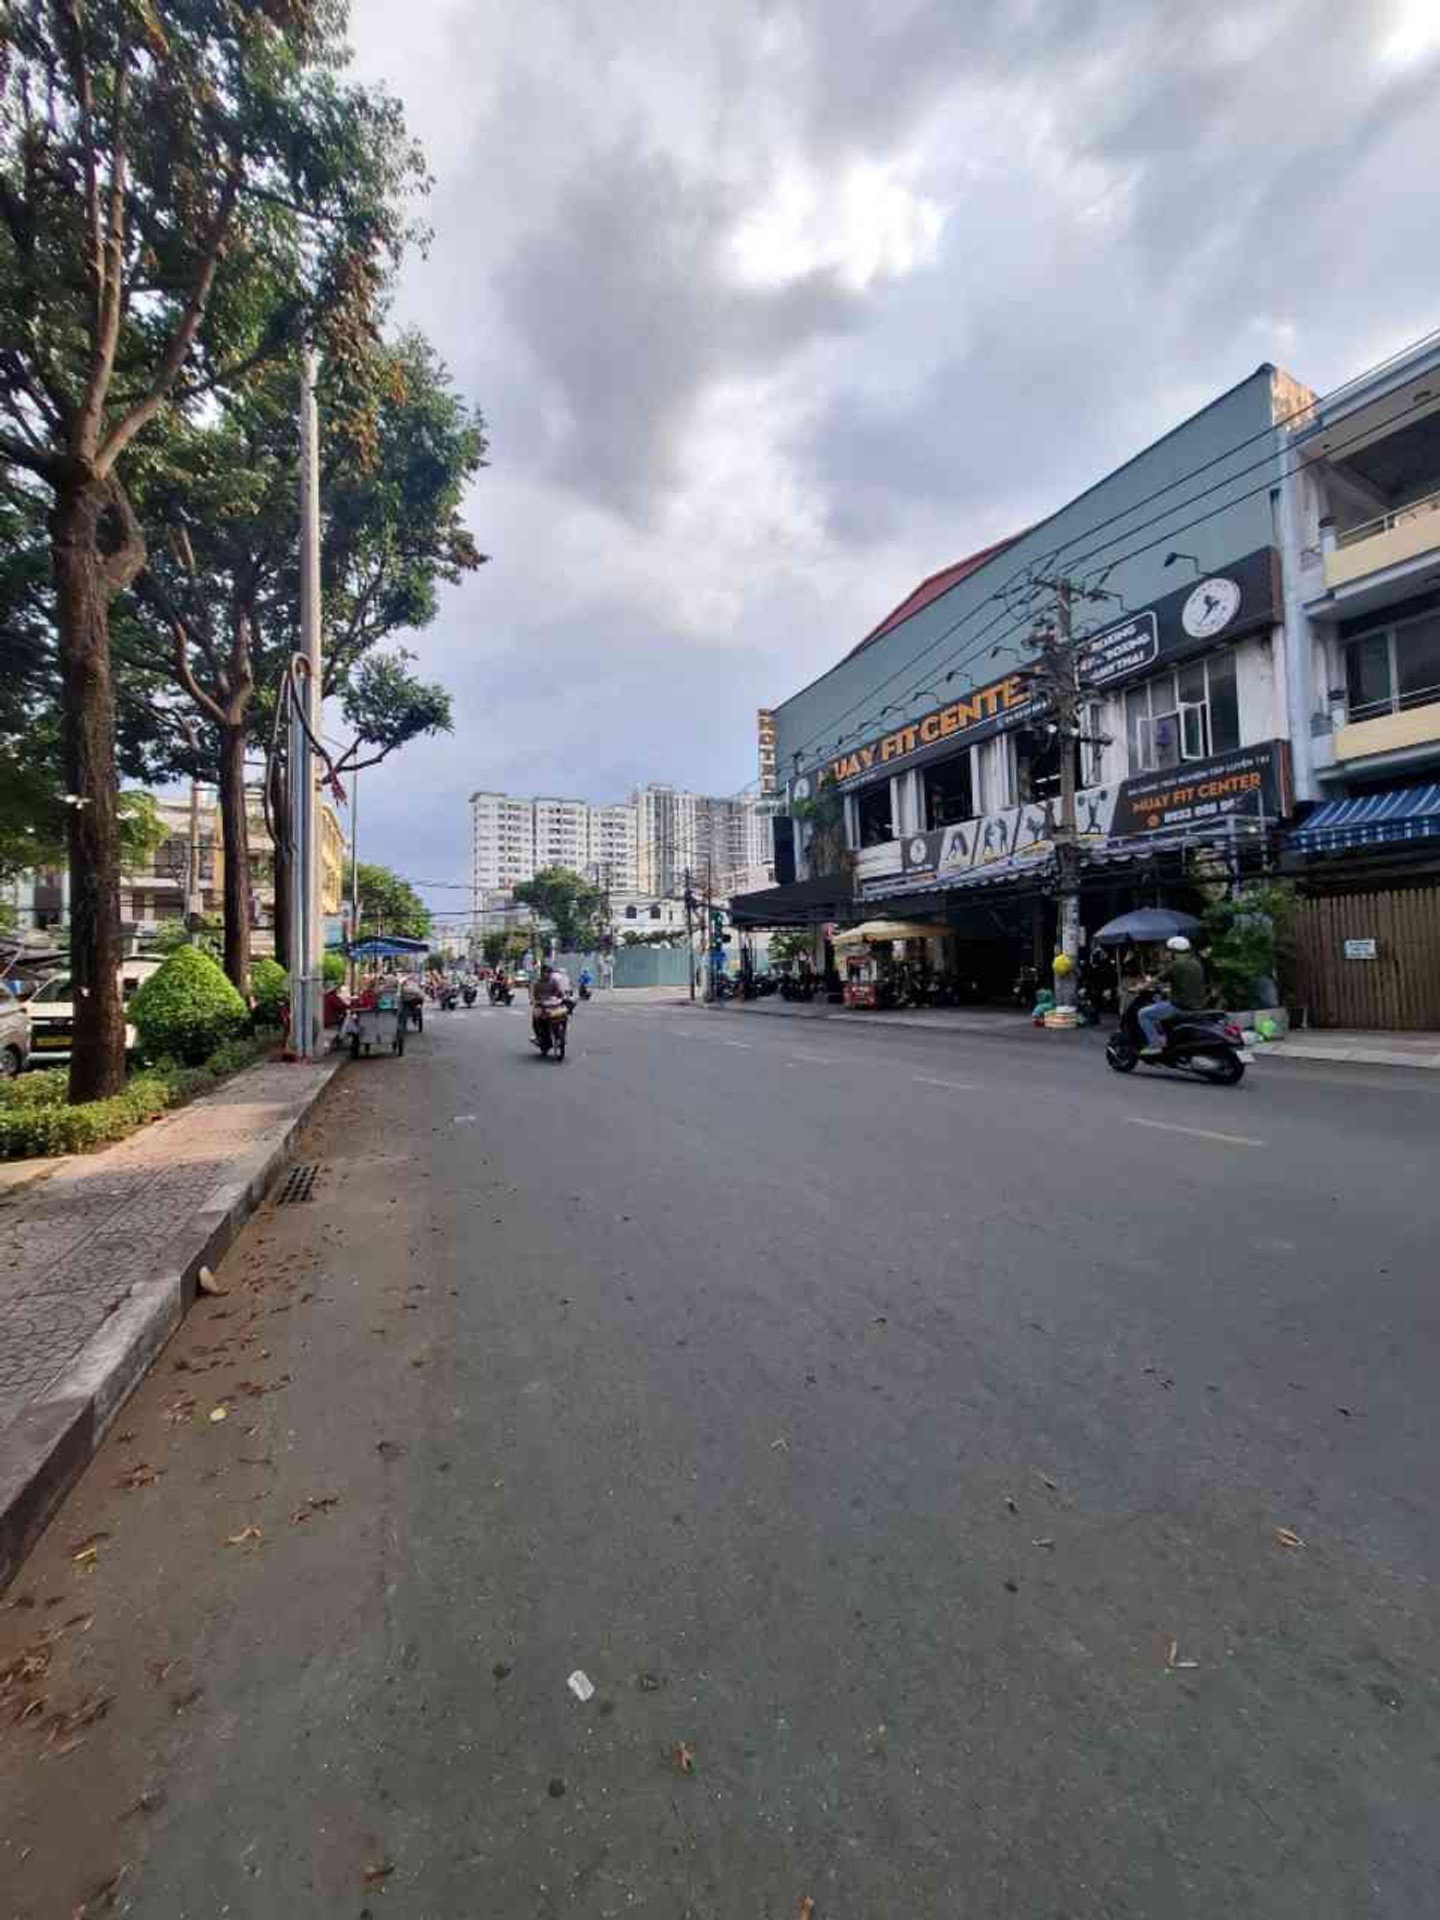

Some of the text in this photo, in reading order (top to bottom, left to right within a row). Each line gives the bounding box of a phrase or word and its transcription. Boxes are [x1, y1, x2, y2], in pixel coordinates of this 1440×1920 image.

[881, 725, 919, 762] FIT
[920, 664, 1046, 742] CENTE
[1173, 787, 1197, 805] FIT
[1198, 772, 1262, 798] CENTER
